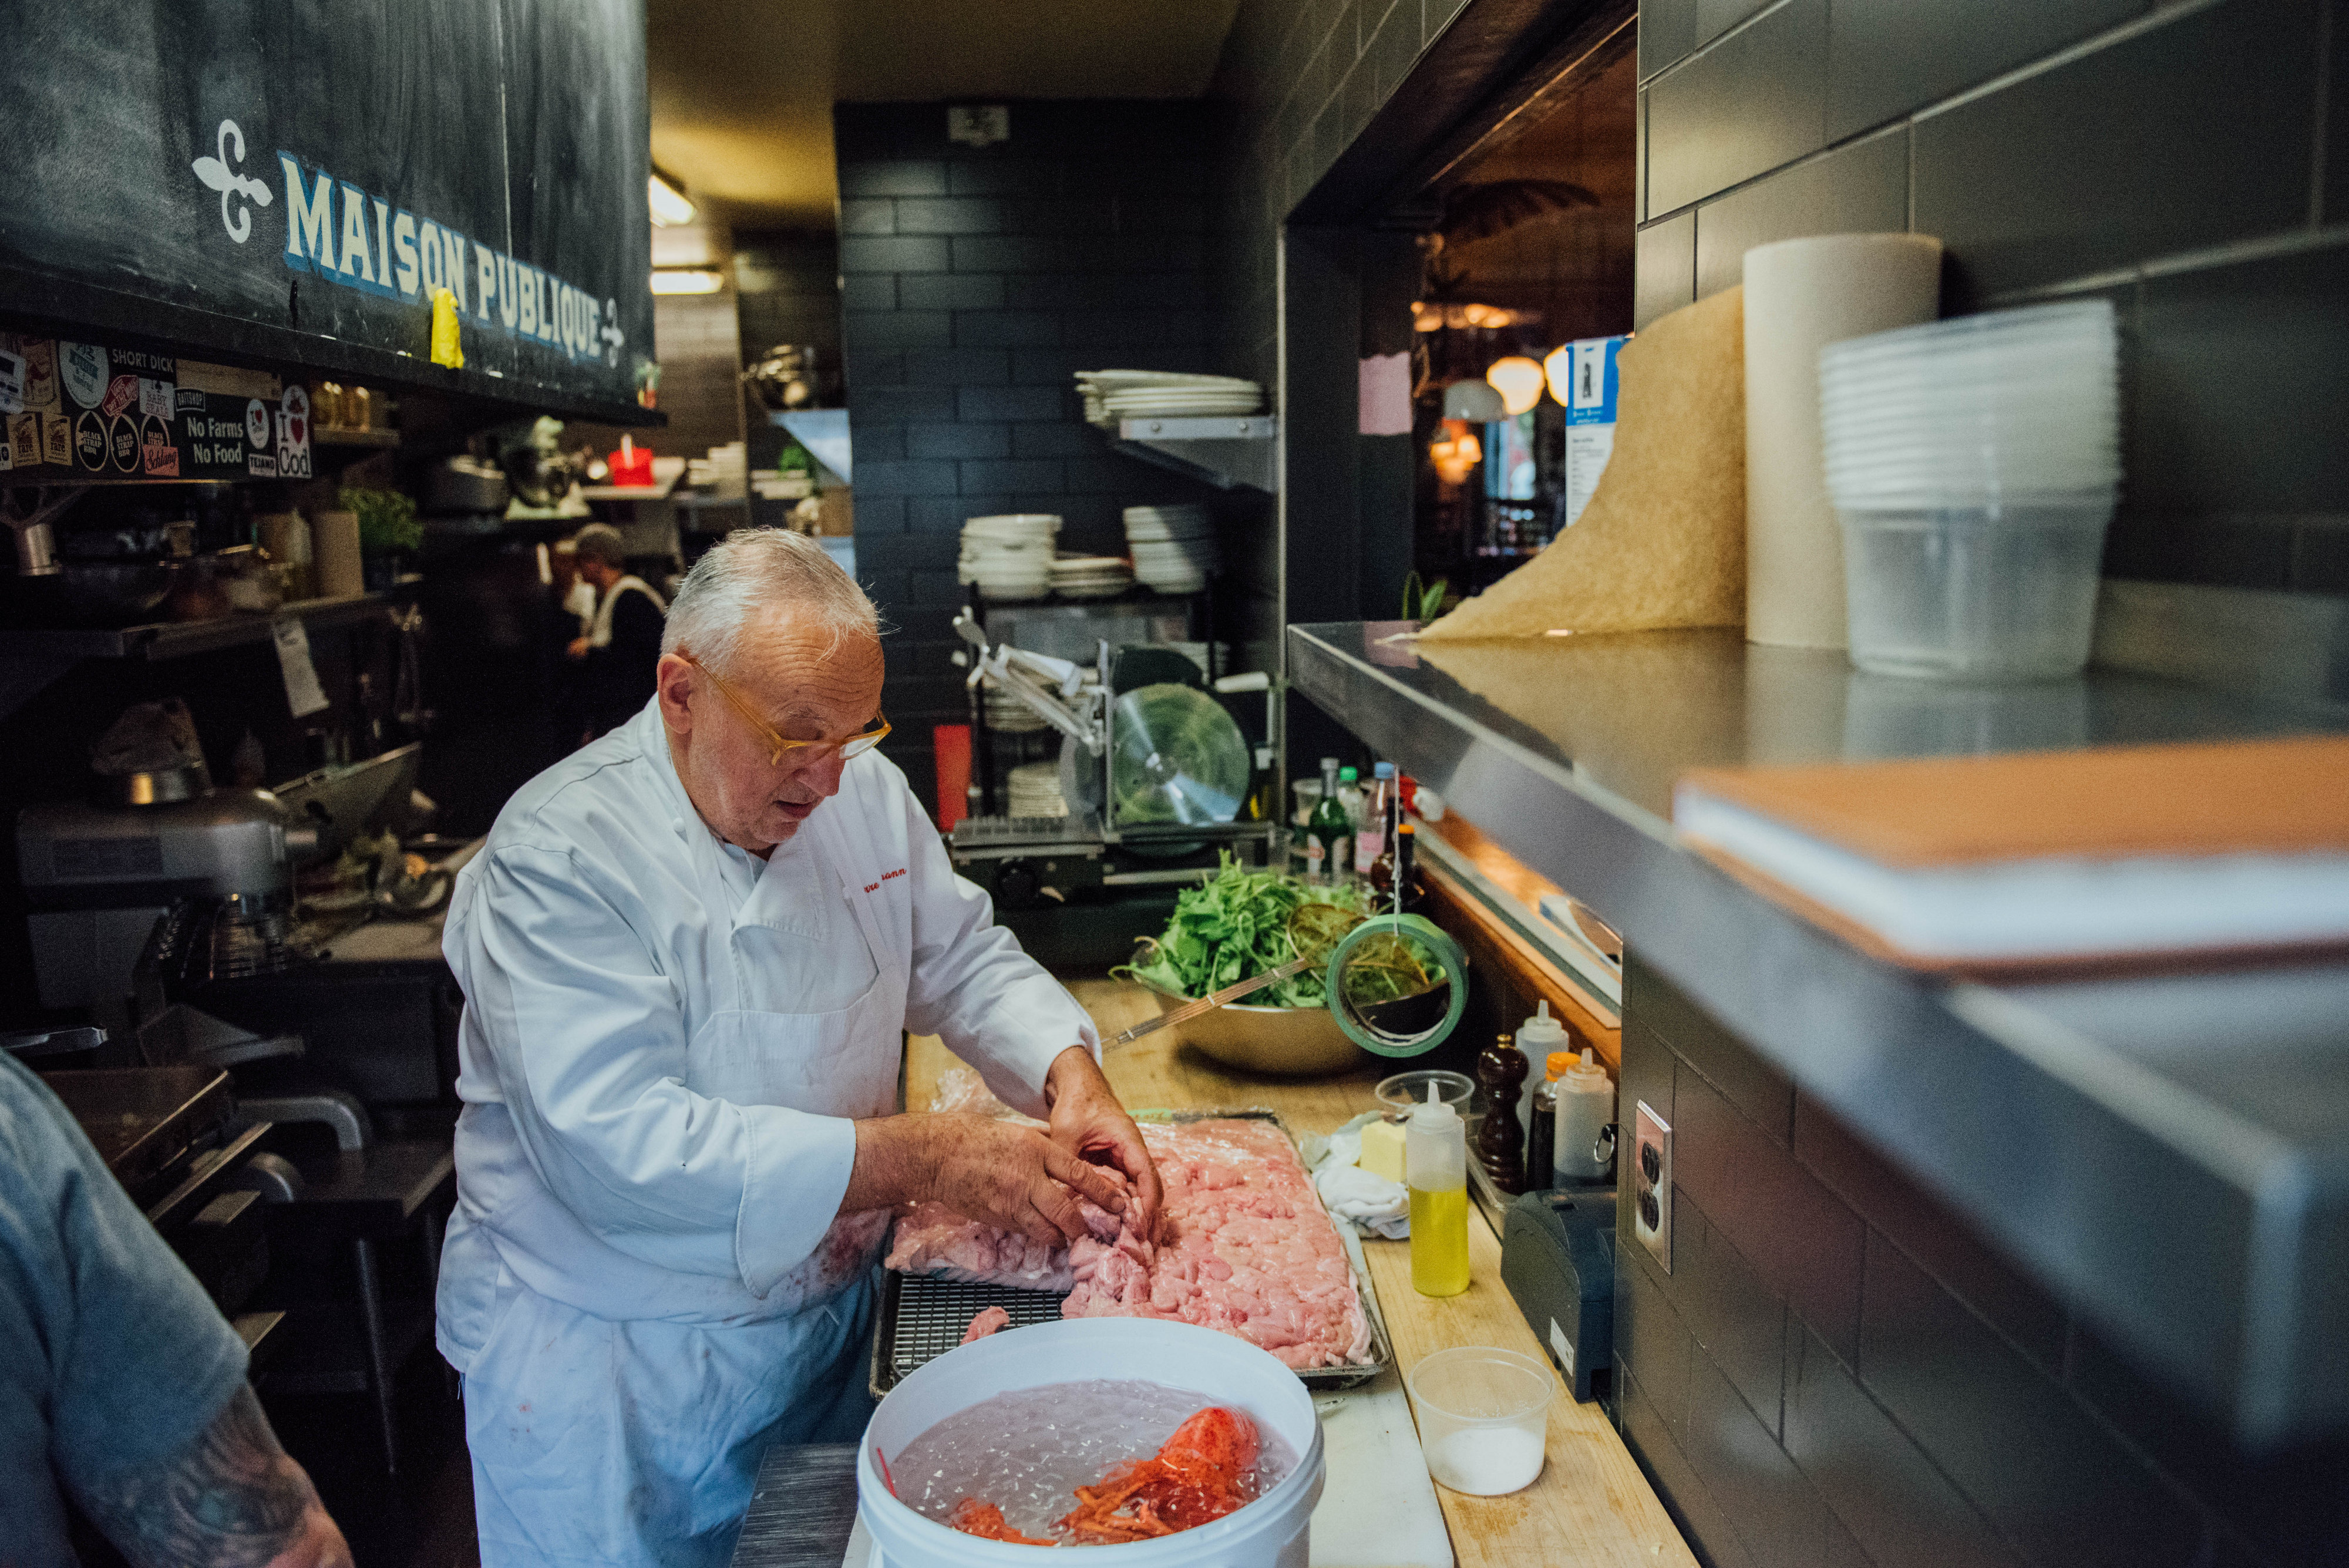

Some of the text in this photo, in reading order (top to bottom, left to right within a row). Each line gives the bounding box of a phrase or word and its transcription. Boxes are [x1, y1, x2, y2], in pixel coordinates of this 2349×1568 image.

[280, 152, 602, 359] MAISON PUBLIQUE
[112, 348, 147, 368] SHORT
[149, 354, 174, 374] DICK
[187, 416, 205, 438] No
[207, 417, 244, 438] Farms
[279, 414, 288, 442] I
[83, 430, 102, 441] BLACK
[83, 438, 102, 448] STRAP
[116, 433, 133, 443] BLACK
[18, 443, 33, 454] rare
[51, 442, 66, 453] rare
[117, 440, 134, 450] STRAP
[193, 441, 243, 464] No Food
[280, 446, 309, 475] Cod
